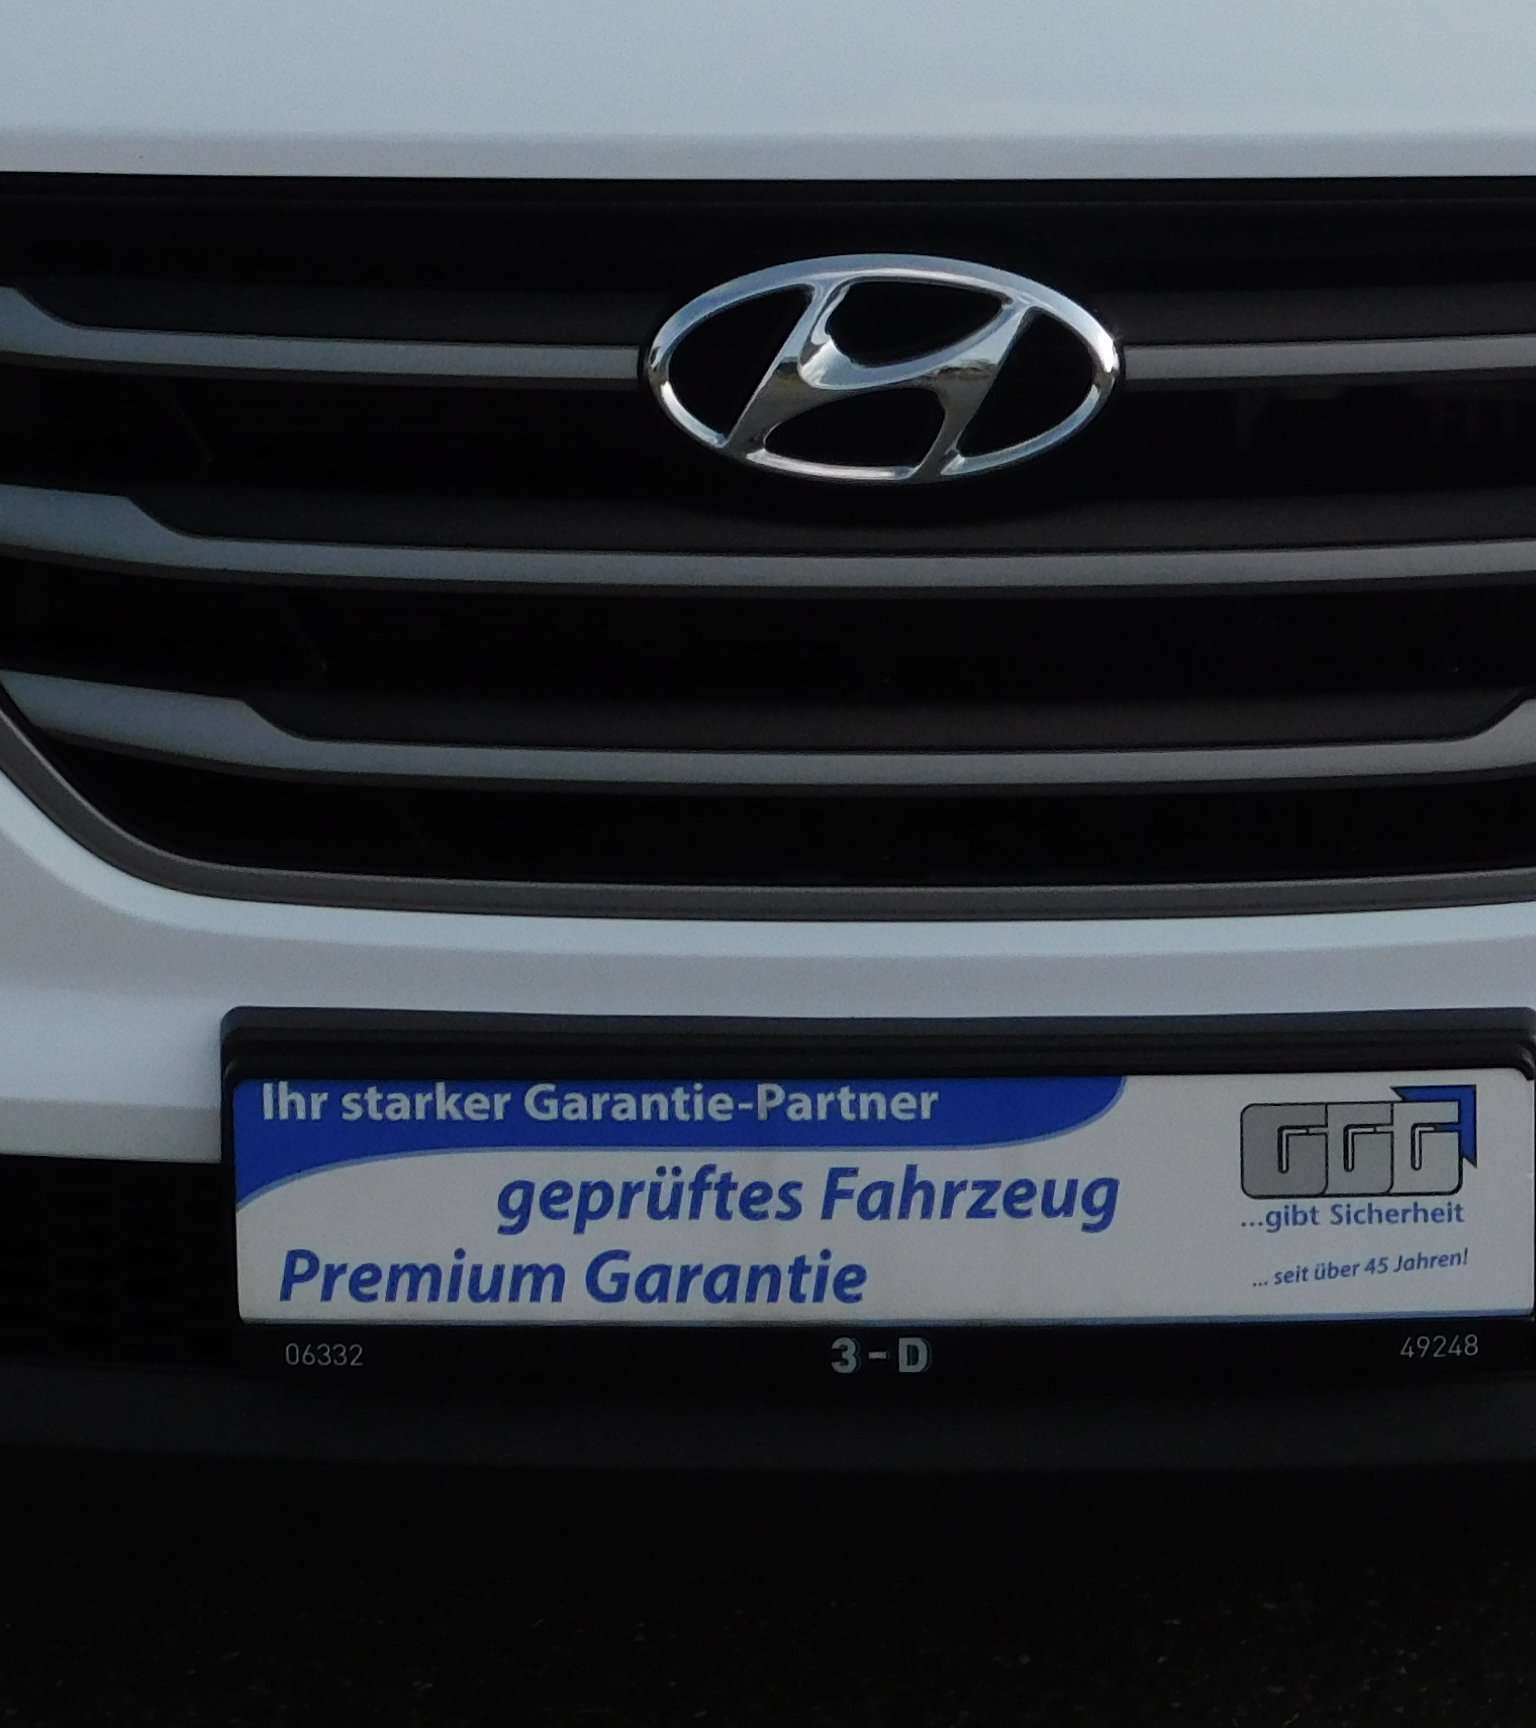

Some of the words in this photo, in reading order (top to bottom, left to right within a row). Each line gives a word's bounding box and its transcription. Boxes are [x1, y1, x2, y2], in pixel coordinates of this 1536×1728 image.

[263, 1081, 328, 1121] Ihr
[341, 1082, 511, 1122] starker
[524, 1082, 939, 1122] Garantie-Partner
[497, 1163, 804, 1236] geprüftes
[820, 1164, 1120, 1234] Fahrzeug
[1329, 1201, 1464, 1226] Sicherheit
[279, 1247, 566, 1304] Premium
[585, 1248, 868, 1305] Garantie
[1273, 1265, 1309, 1285] seit
[1313, 1261, 1360, 1282] über
[1364, 1256, 1389, 1275] 45
[1392, 1247, 1469, 1273] Jahren!
[285, 1342, 364, 1367] 06332
[1399, 1333, 1480, 1358] 49248
